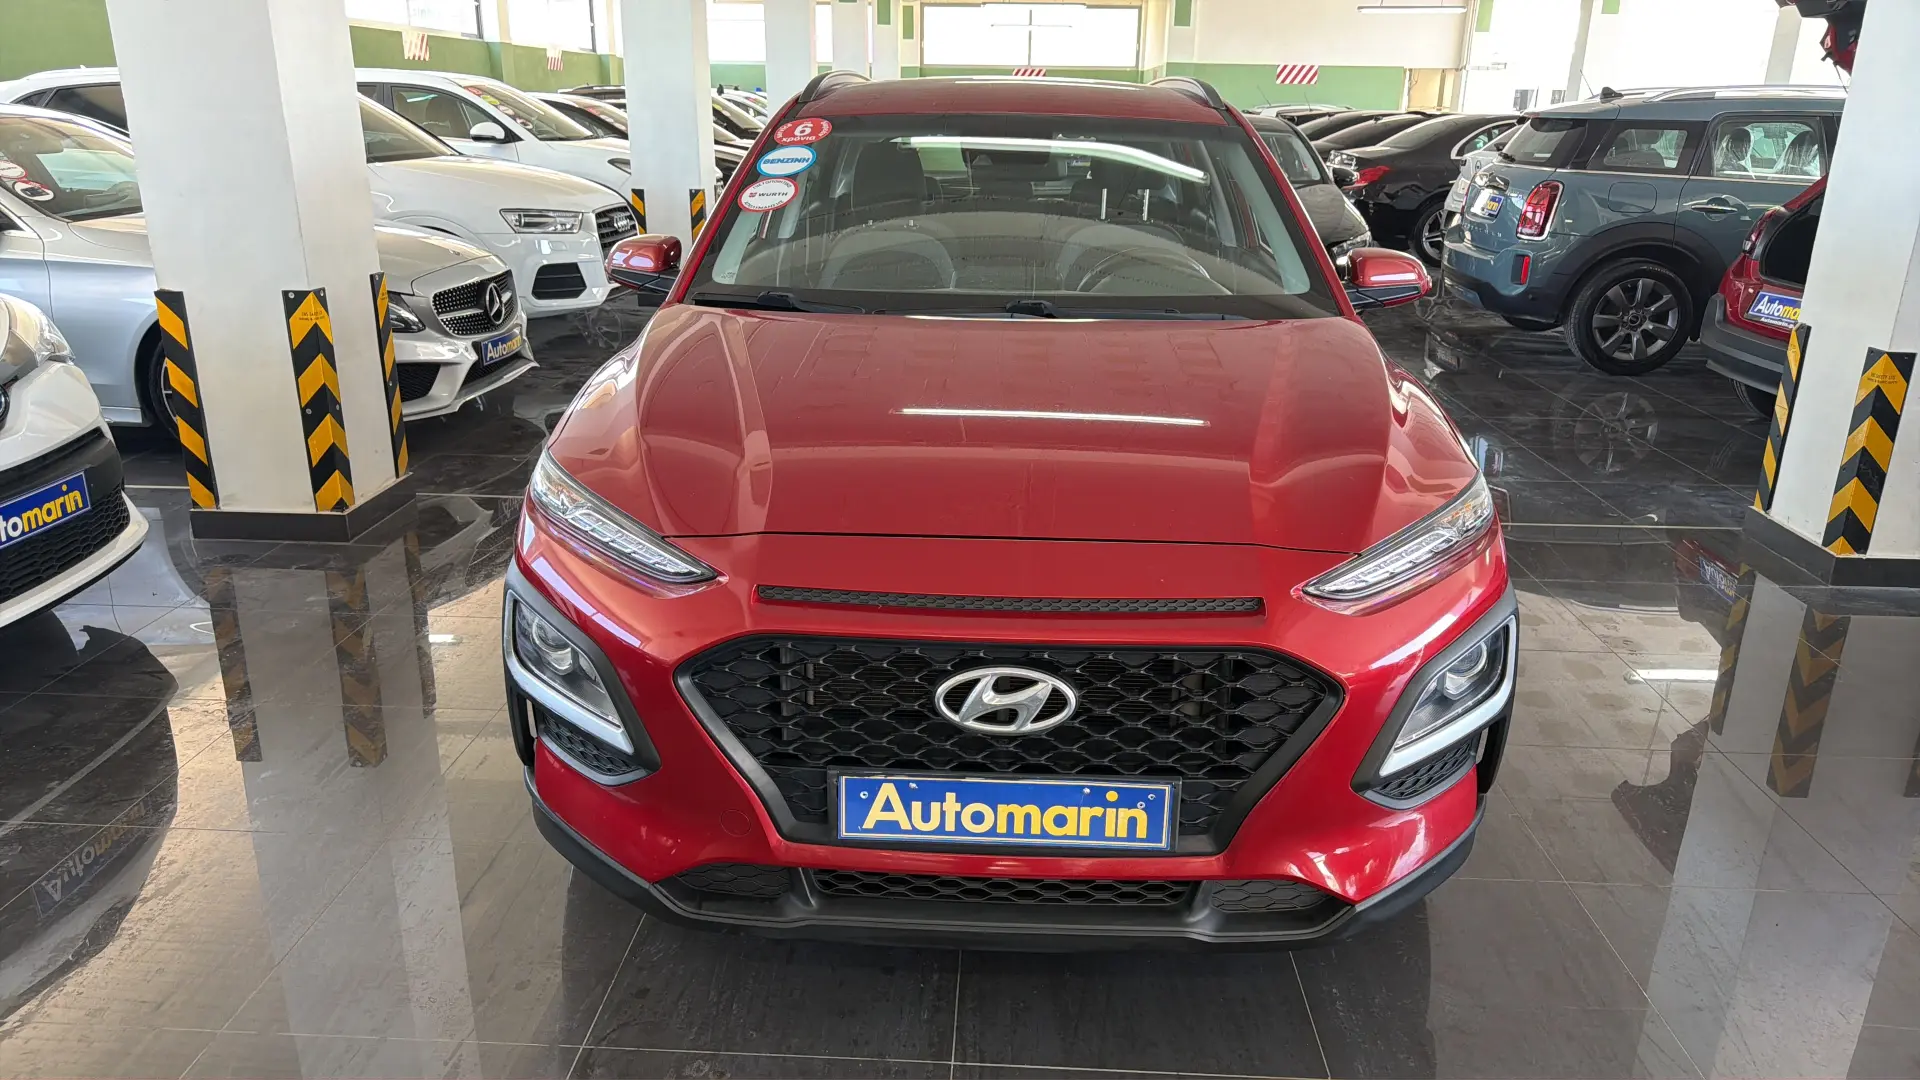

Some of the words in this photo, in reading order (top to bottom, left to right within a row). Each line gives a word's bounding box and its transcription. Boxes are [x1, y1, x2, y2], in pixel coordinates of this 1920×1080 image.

[794, 123, 813, 136] 6
[1754, 296, 1801, 320] Automa
[0, 484, 84, 543] tomarin
[862, 782, 1149, 839] Automarin
